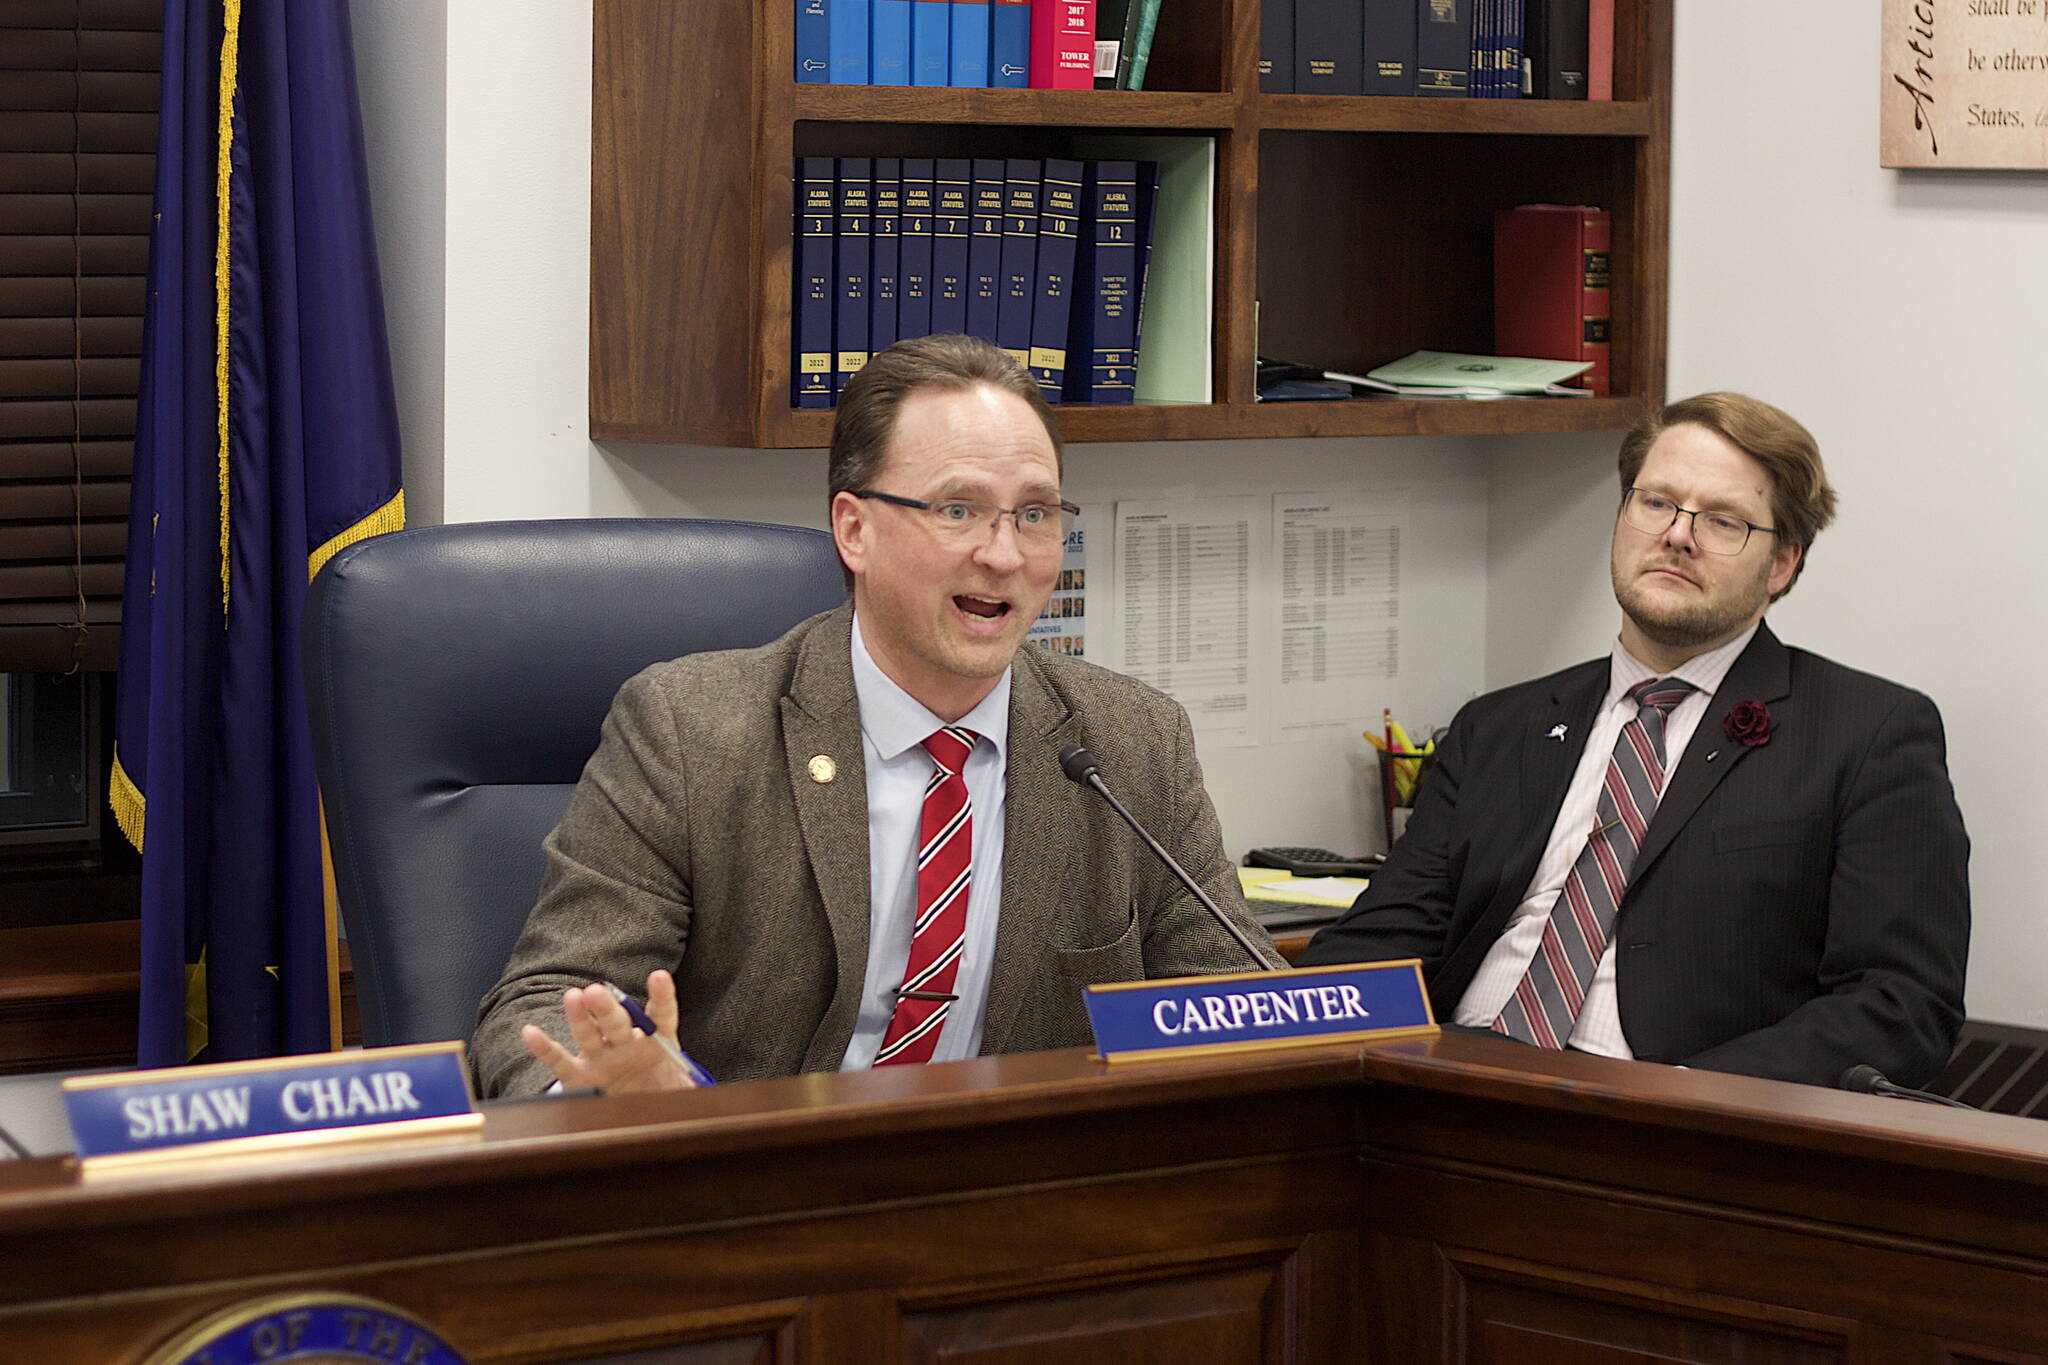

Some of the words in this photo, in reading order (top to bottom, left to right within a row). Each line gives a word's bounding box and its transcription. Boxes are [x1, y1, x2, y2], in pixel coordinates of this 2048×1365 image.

[1067, 6, 1085, 15] 2017
[1968, 0, 2009, 15] shall
[2017, 0, 2035, 15] be
[1067, 17, 1085, 26] 2018
[1061, 52, 1090, 61] TOWER
[1968, 48, 1986, 70] be
[1967, 103, 2025, 129] States,
[810, 190, 829, 198] ALASKA
[847, 190, 866, 198] ALASKA
[909, 190, 929, 198] ALASKA
[980, 191, 1000, 199] ALASKA
[1013, 191, 1033, 199] ALASKA
[1053, 191, 1072, 200] ALASKA
[1106, 193, 1126, 201] ALASKA
[807, 199, 831, 207] STATUTES
[844, 199, 868, 207] STATUTES
[906, 199, 930, 207] STATUTES
[941, 200, 965, 208] STATUTES
[978, 200, 1001, 208] STATUTES
[1011, 200, 1034, 208] STATUTES
[1050, 199, 1073, 209] STATUTES
[1103, 203, 1129, 212] STATUTES
[815, 219, 822, 232] 3
[852, 219, 859, 231] 4
[885, 220, 892, 232] 5
[914, 219, 921, 231] 6
[948, 220, 956, 232] 7
[985, 220, 992, 232] 8
[1017, 220, 1025, 232] 9
[1054, 219, 1066, 232] 10
[1110, 226, 1121, 239] 12
[1153, 985, 1370, 1035] CARPENTER
[124, 1085, 251, 1139] SHAW
[282, 1070, 420, 1123] CHAIR
[252, 1312, 312, 1358] OF
[342, 1313, 433, 1365] THE
